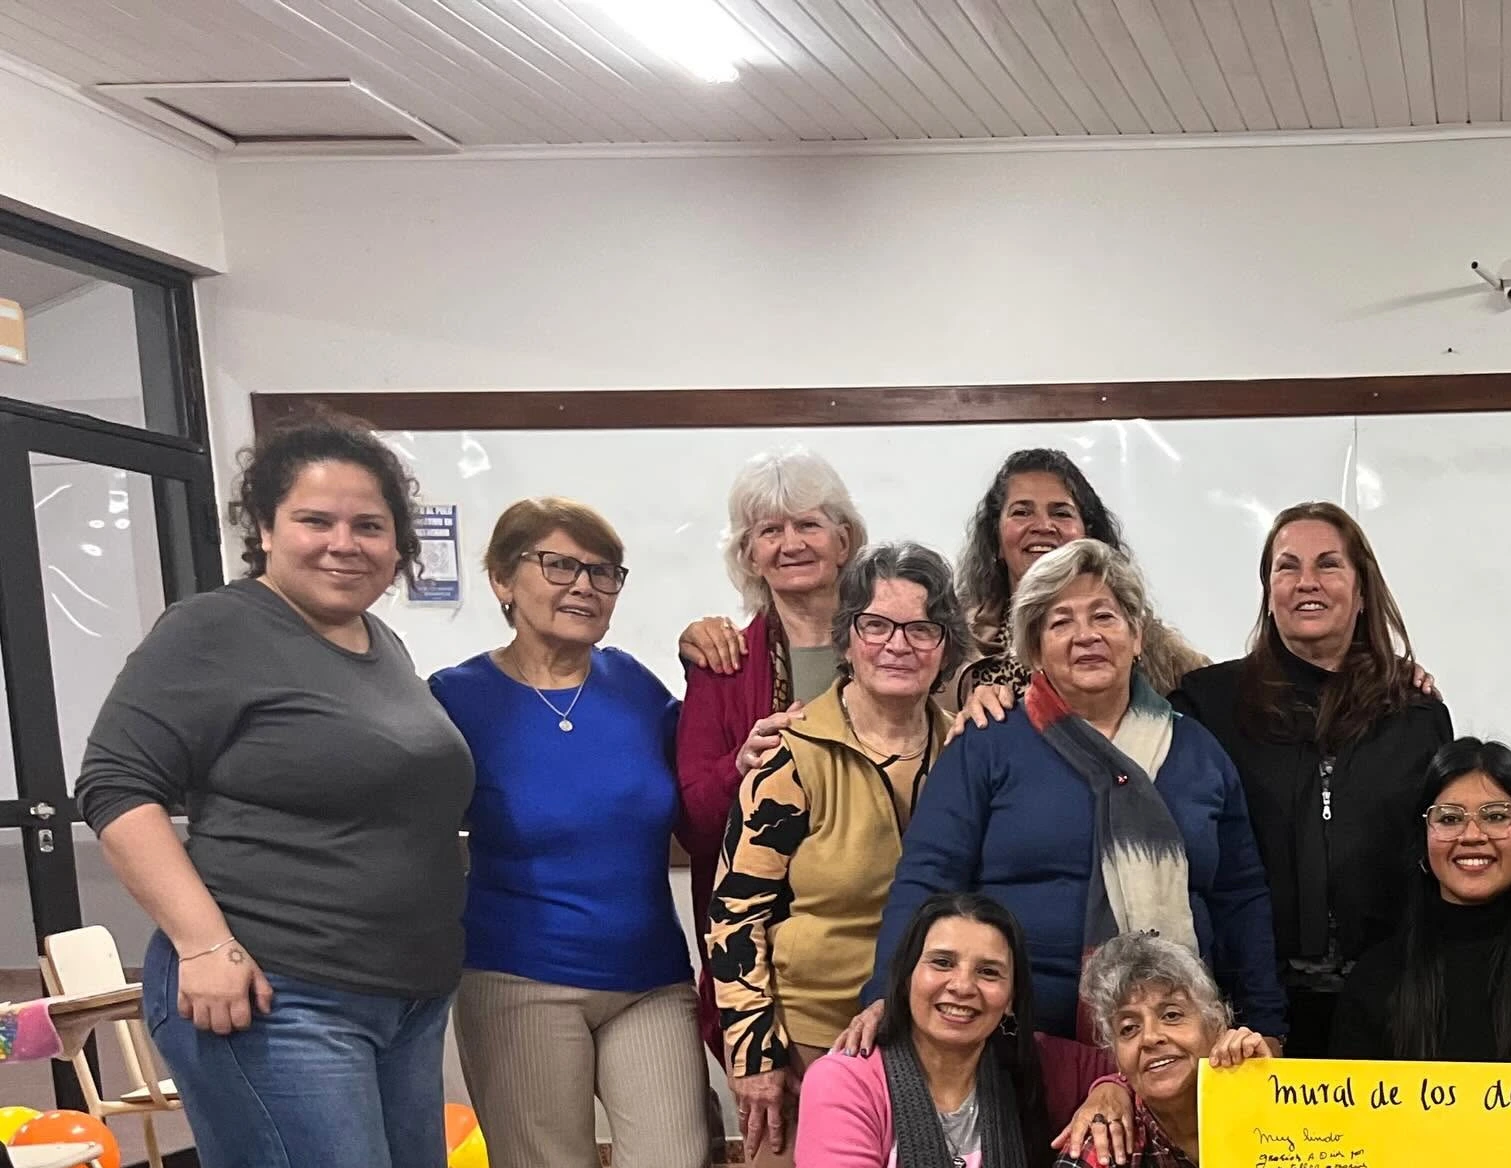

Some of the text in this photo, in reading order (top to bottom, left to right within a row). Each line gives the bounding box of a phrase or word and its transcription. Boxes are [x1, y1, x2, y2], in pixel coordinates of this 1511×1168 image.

[1268, 1074, 1355, 1108] mural
[1371, 1080, 1402, 1109] de
[1420, 1078, 1457, 1111] los
[1303, 1127, 1344, 1143] lindo
